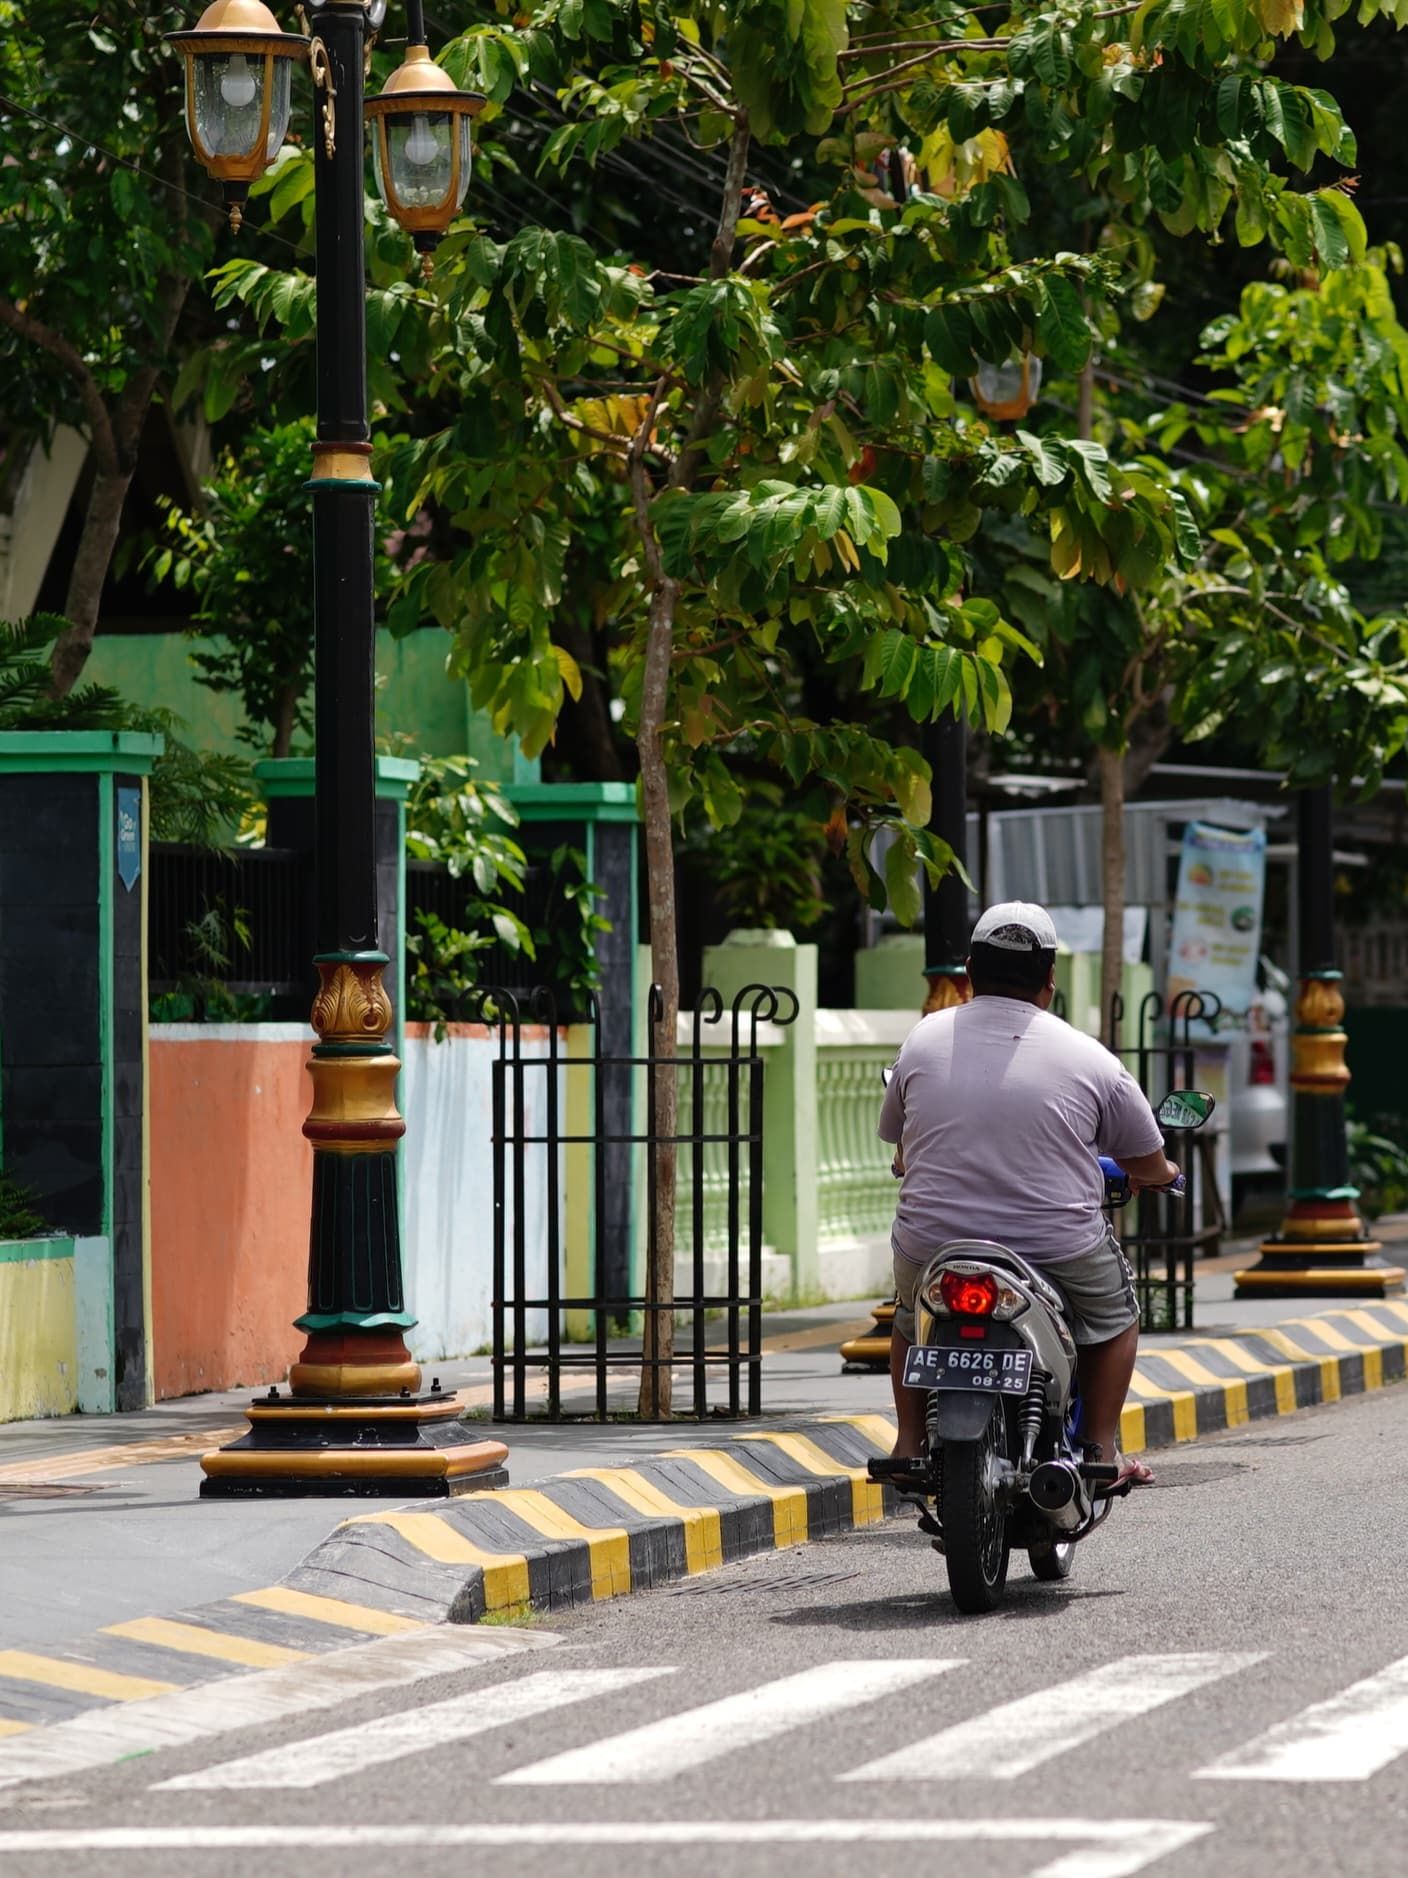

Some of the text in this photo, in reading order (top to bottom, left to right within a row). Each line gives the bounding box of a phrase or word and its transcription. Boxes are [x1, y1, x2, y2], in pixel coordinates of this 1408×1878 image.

[913, 1350, 1027, 1372] AE 6626 DE
